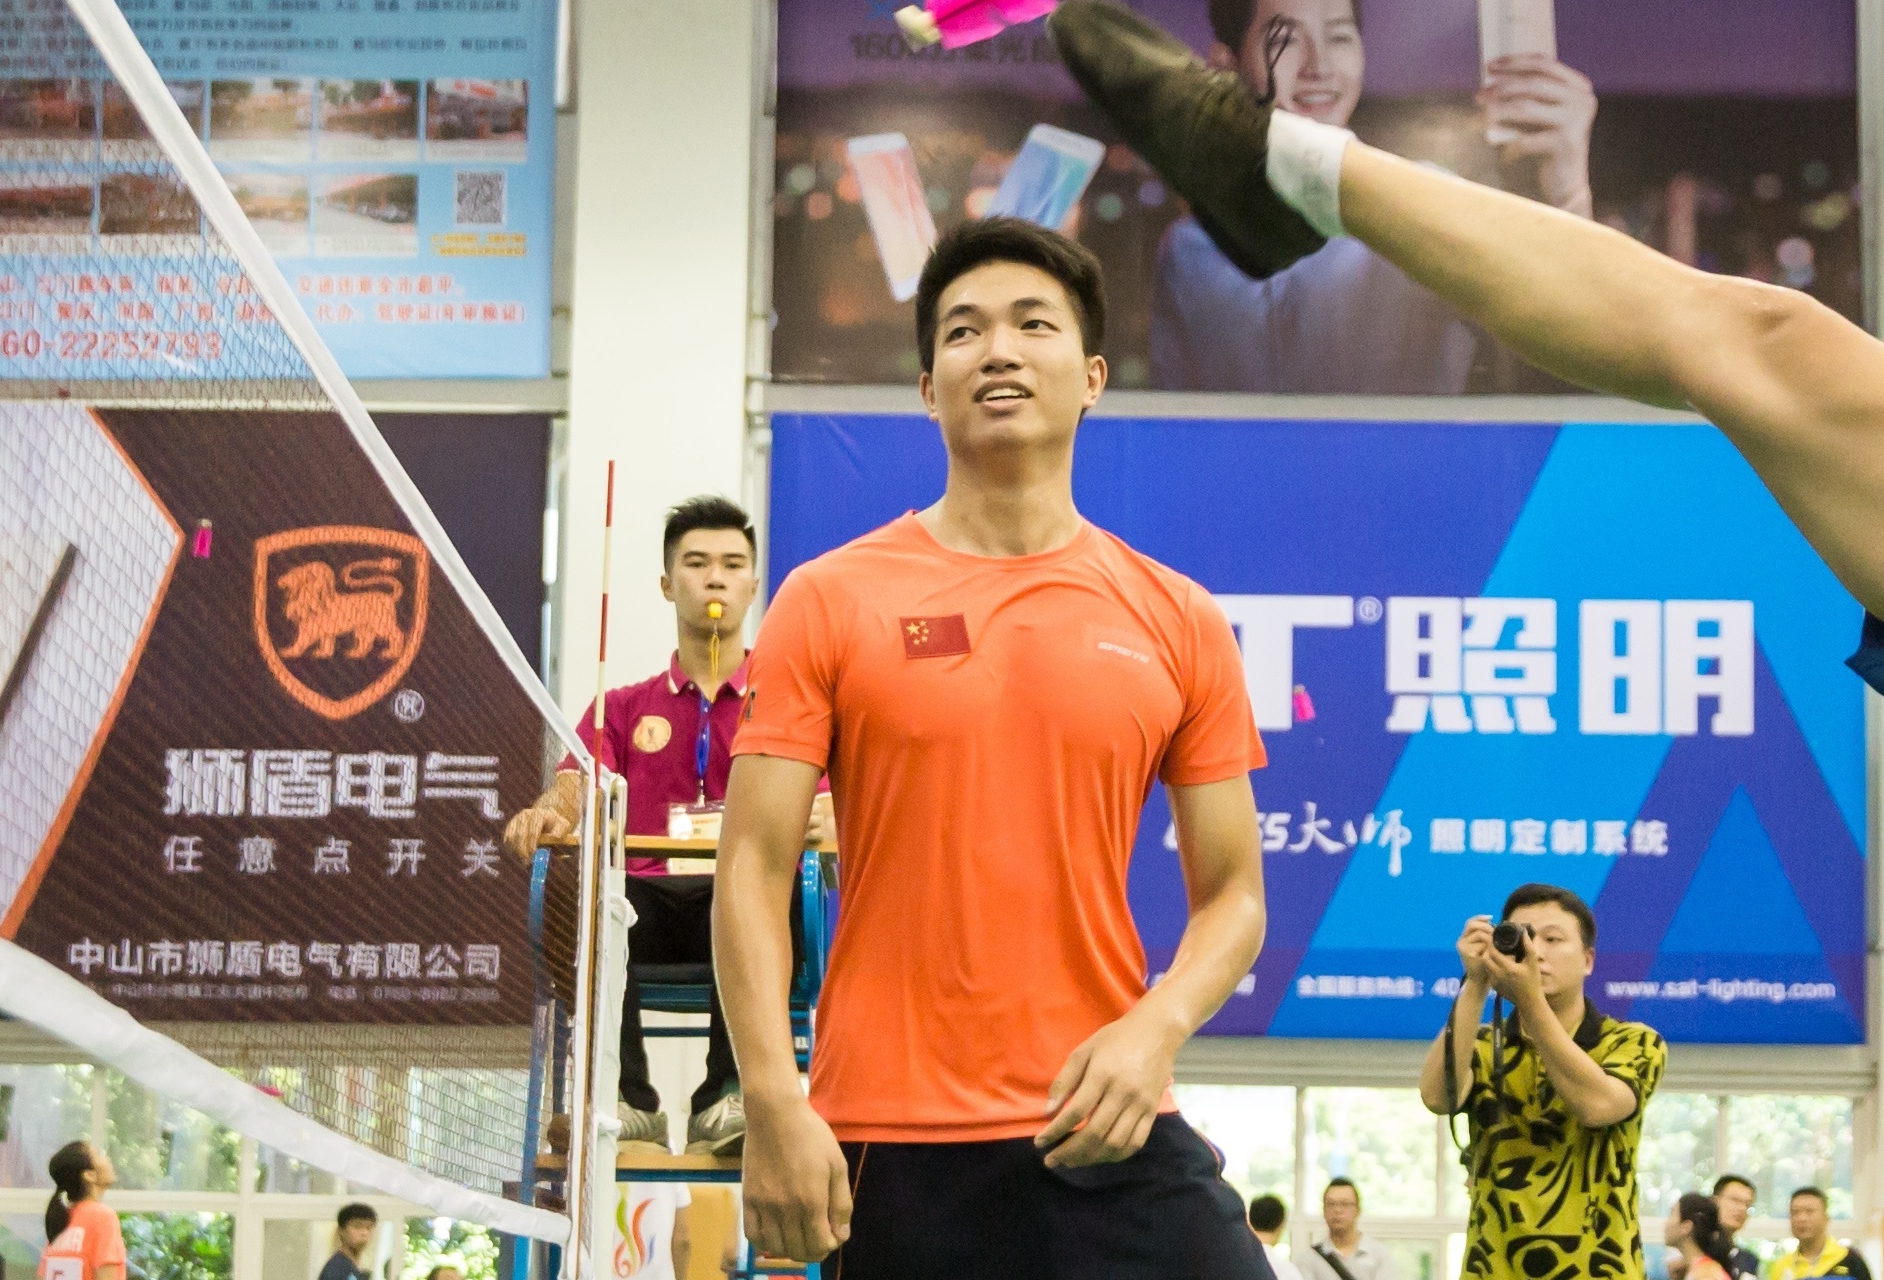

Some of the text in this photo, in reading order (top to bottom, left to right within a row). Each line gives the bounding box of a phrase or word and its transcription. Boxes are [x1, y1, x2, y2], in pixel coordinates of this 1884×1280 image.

[163, 748, 504, 820] 狮盾电气
[163, 835, 501, 876] 任意点开关
[1429, 817, 1668, 856] 照明定制系统
[67, 937, 501, 979] 中山市狮盾电气有限公司
